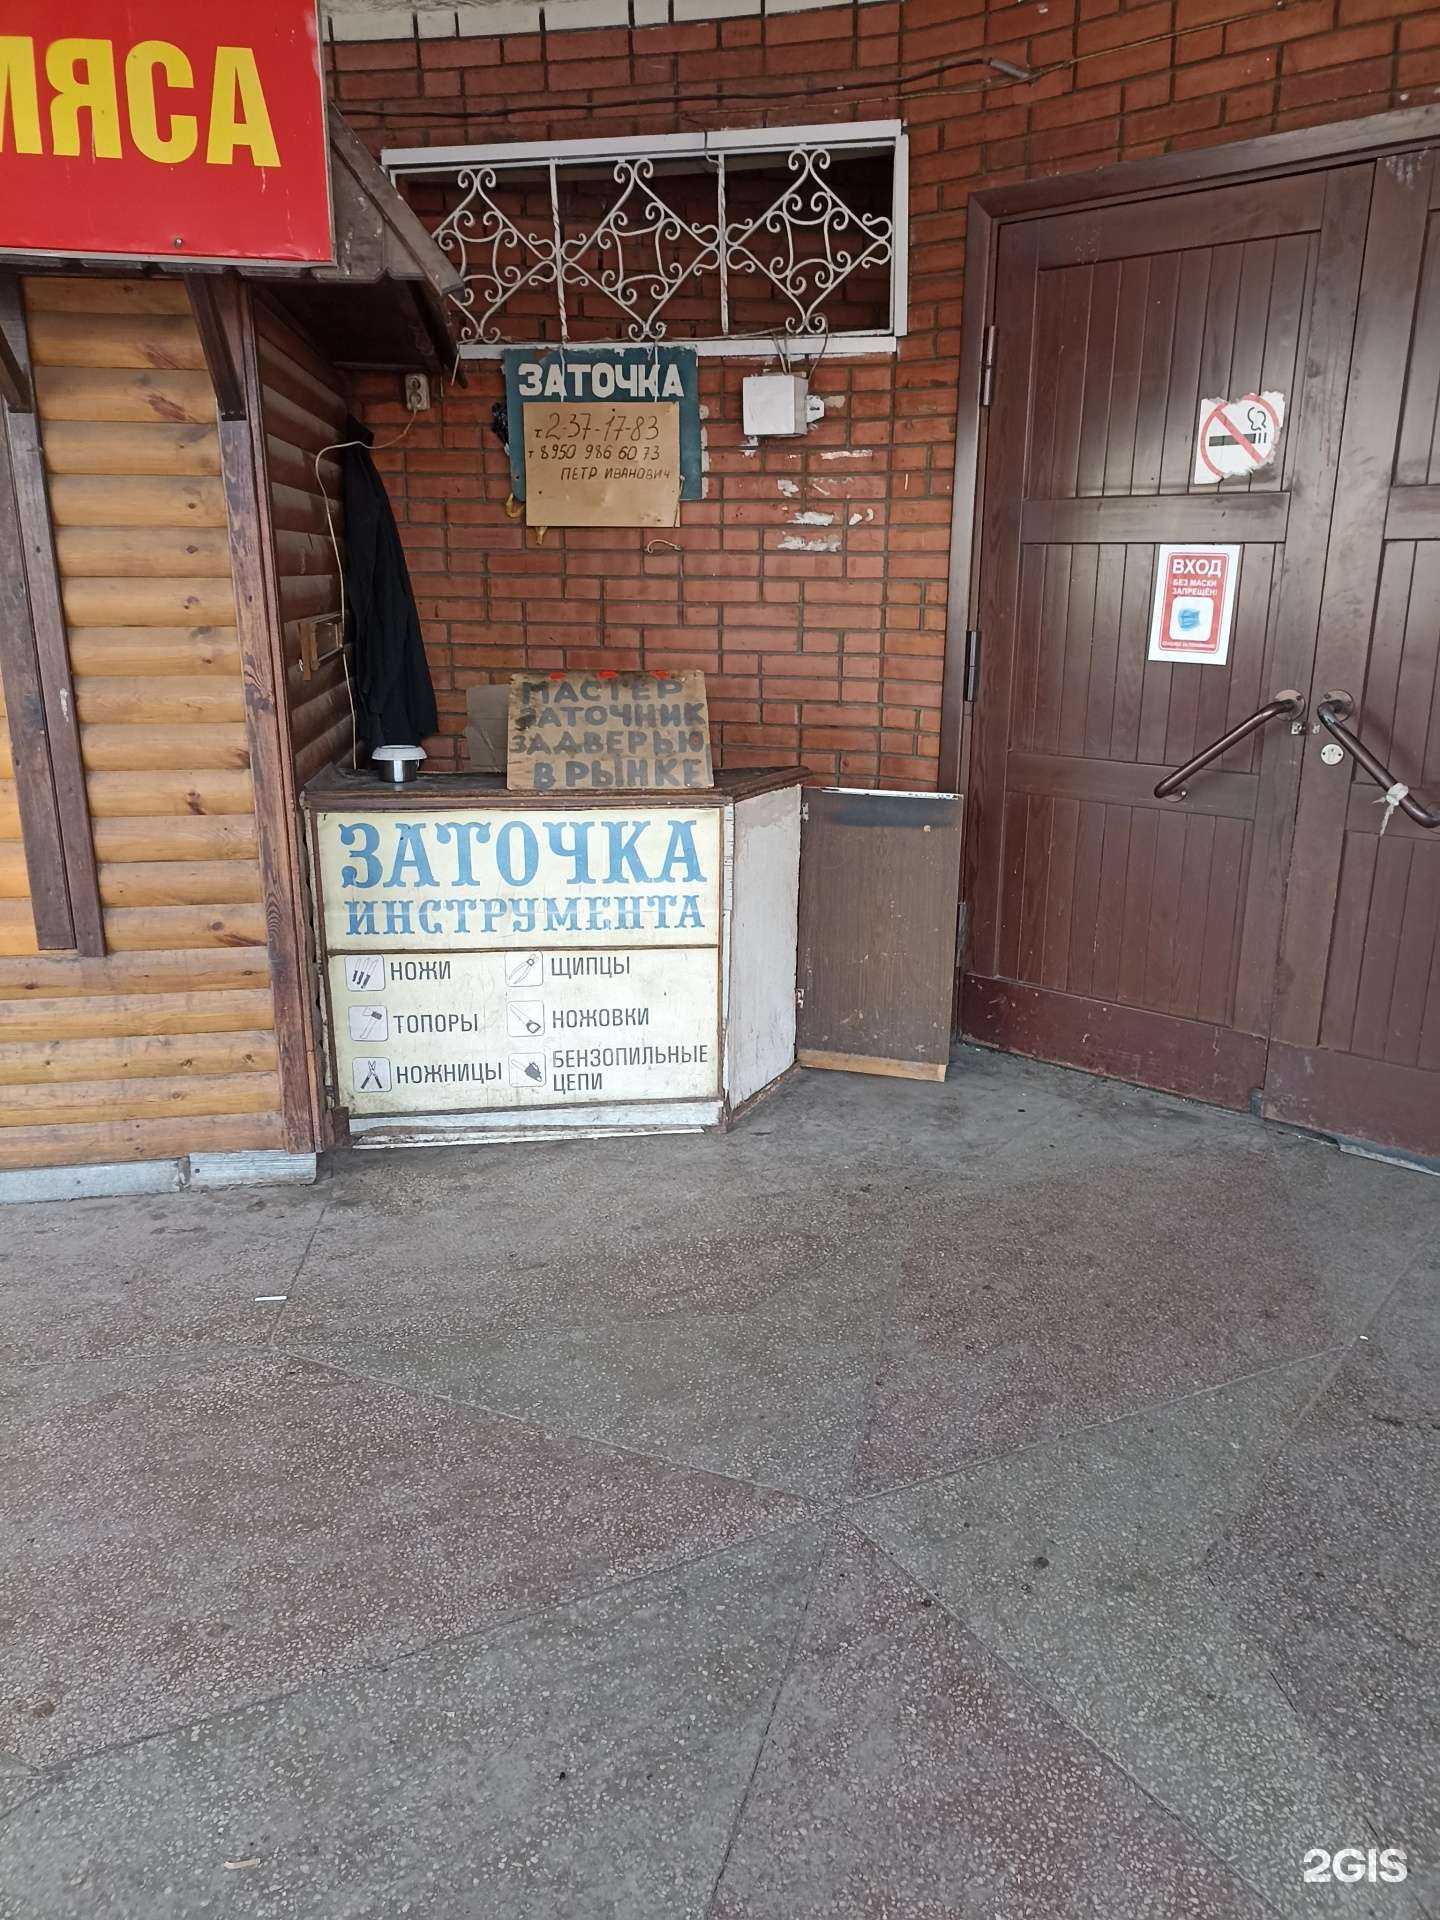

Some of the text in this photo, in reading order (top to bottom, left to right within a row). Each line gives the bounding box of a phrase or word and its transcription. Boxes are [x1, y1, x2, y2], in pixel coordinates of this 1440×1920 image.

[518, 362, 684, 398] ЗАТОЧКА
[541, 444, 576, 460] 8950
[584, 444, 612, 460] 986
[617, 445, 638, 460] 60
[560, 466, 598, 480] ПЕТР
[1172, 559, 1222, 577] ВХОД
[522, 679, 683, 703] МАСТЕР
[515, 702, 706, 730] ЗАТОЧНИК
[565, 758, 701, 787] РЫНКЕ
[340, 820, 708, 889] ЗАТОЧКА
[344, 894, 706, 936] ИНСТРУМЕНТА
[390, 961, 452, 981] НОЖИ
[551, 956, 631, 979] ЩИПЦЫ
[393, 1013, 478, 1034] ТОПОРЫ
[552, 1007, 650, 1029] НОЖОВКИ
[552, 1044, 709, 1069] БЕНЗОПИЛЬНЫЕ
[396, 1062, 502, 1086] НОЖНИЦЫ
[553, 1073, 603, 1094] ЦЕПИ
